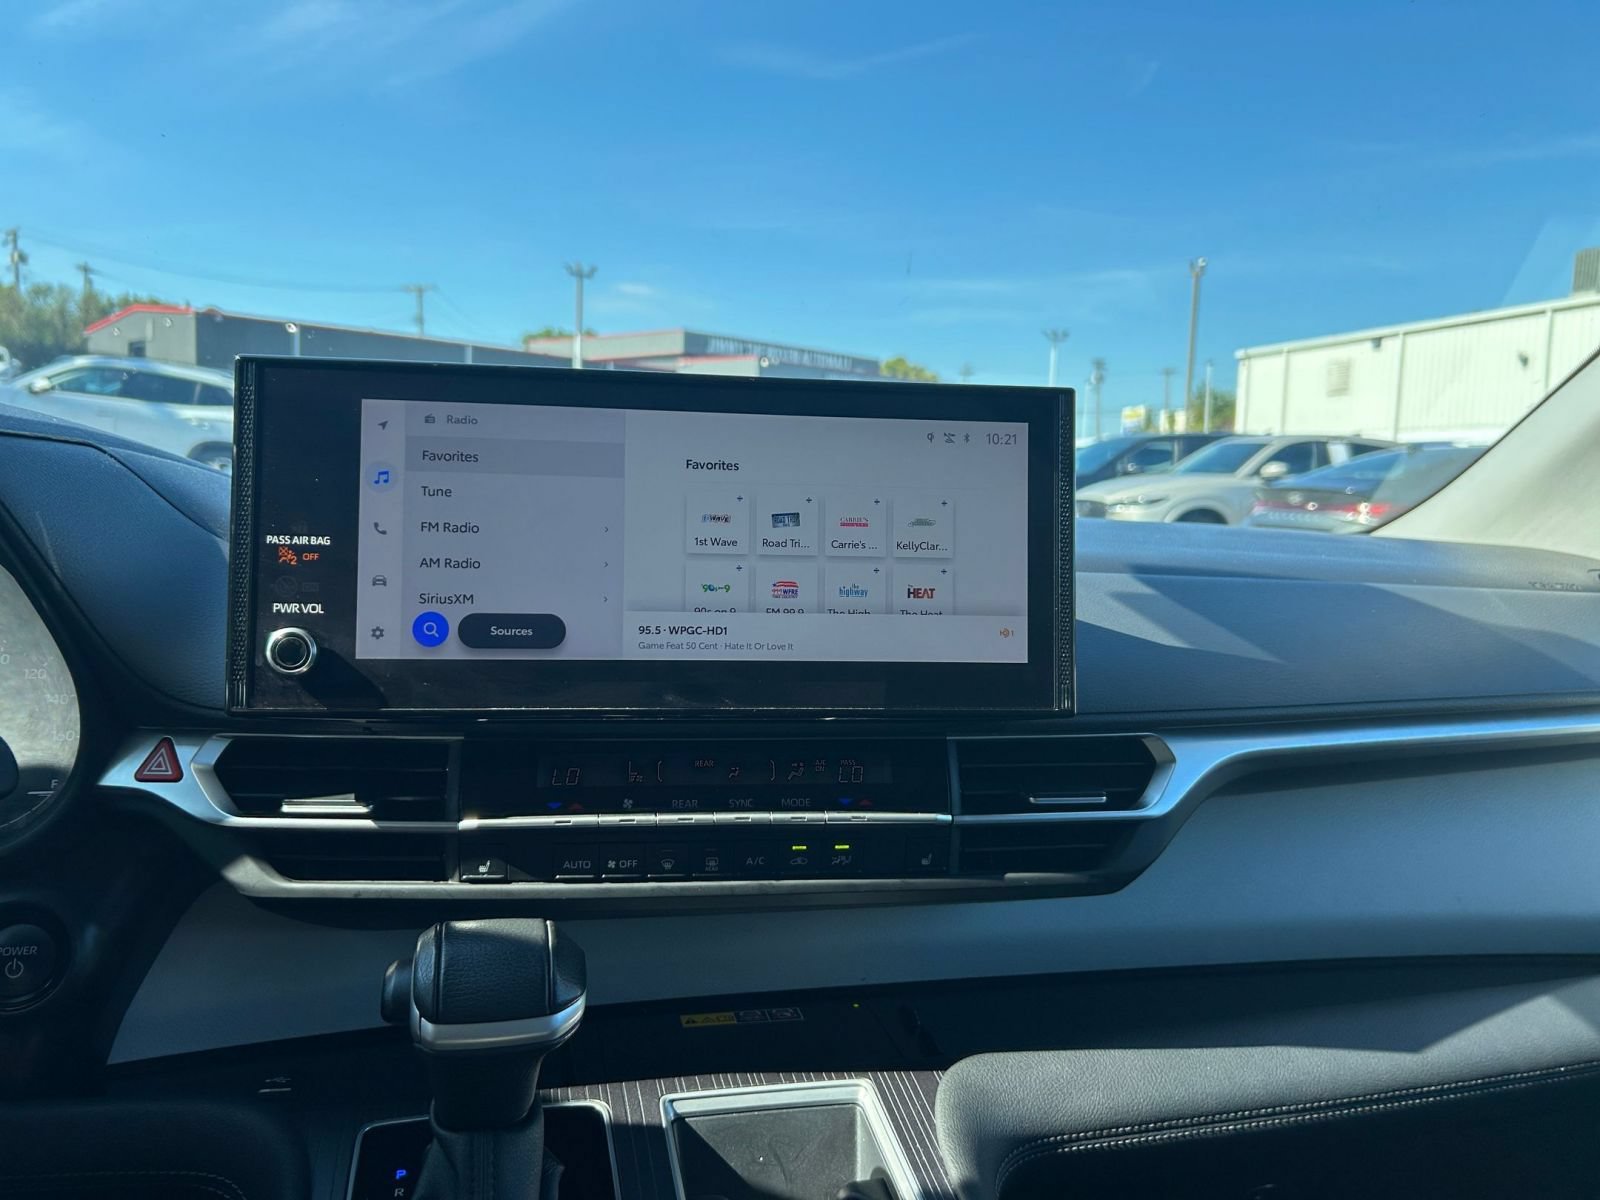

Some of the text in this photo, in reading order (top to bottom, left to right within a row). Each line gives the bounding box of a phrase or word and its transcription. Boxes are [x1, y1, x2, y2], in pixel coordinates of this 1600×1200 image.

[446, 415, 479, 425] Radio
[986, 433, 1017, 445] 10:21
[422, 450, 479, 463] Favorites
[686, 459, 740, 471] Favorites
[421, 486, 452, 498] Tune
[421, 521, 480, 534] FM Radio
[266, 535, 331, 546] PASS AIR BAG
[694, 537, 738, 547] 1st Wave
[762, 538, 788, 548] Road
[831, 540, 866, 549] Carrie's
[896, 541, 948, 553] KellyClar...
[302, 553, 320, 561] OFF
[419, 557, 481, 570] AM Radio
[839, 586, 869, 598] highway
[907, 588, 936, 599] HEAT
[418, 592, 475, 605] SiriusXM
[273, 602, 325, 614] PWR VOL
[490, 625, 533, 636] Sources
[638, 626, 728, 636] 95.5 WPGC-HD1
[638, 641, 794, 651] Game Feat 50 Cent Hate It Or Love It
[24, 668, 48, 680] 120
[694, 759, 714, 768] REAR
[50, 779, 59, 789] F
[672, 799, 698, 809] REAR
[729, 799, 753, 808] SYNC
[781, 798, 812, 808] MODE
[563, 860, 592, 869] AUTO
[619, 859, 638, 868] OFF
[745, 857, 765, 866] A/C
[395, 1169, 407, 1180] P
[394, 1187, 405, 1197] R
